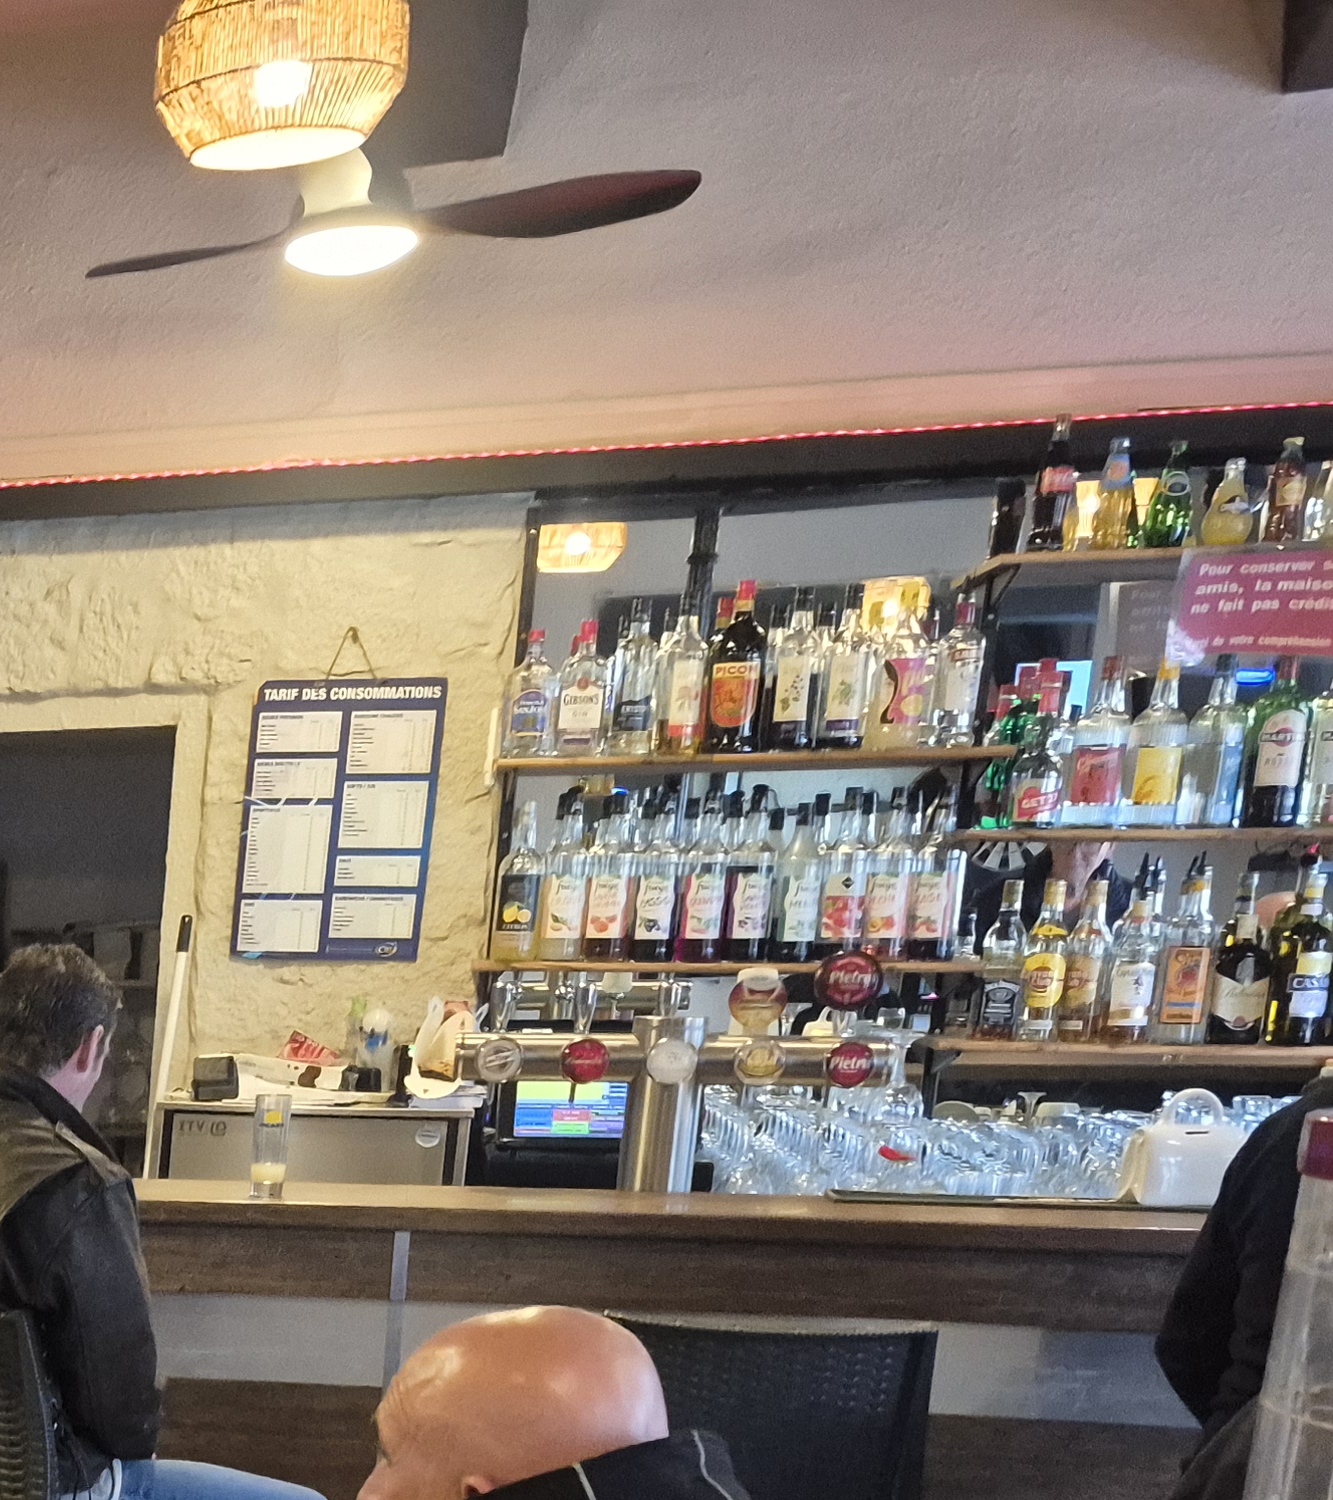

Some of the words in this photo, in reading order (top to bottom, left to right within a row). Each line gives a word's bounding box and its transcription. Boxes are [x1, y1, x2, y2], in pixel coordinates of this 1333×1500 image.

[1199, 563, 1234, 576] Pour
[1240, 560, 1315, 574] conserver
[1195, 581, 1245, 595] amis,
[1255, 578, 1272, 591] la
[1190, 602, 1210, 615] ne
[1218, 598, 1244, 613] fait
[1250, 599, 1280, 614] pas
[264, 687, 300, 702] TARIF
[302, 687, 327, 701] DES
[330, 685, 443, 700] CONSOMMATIONS
